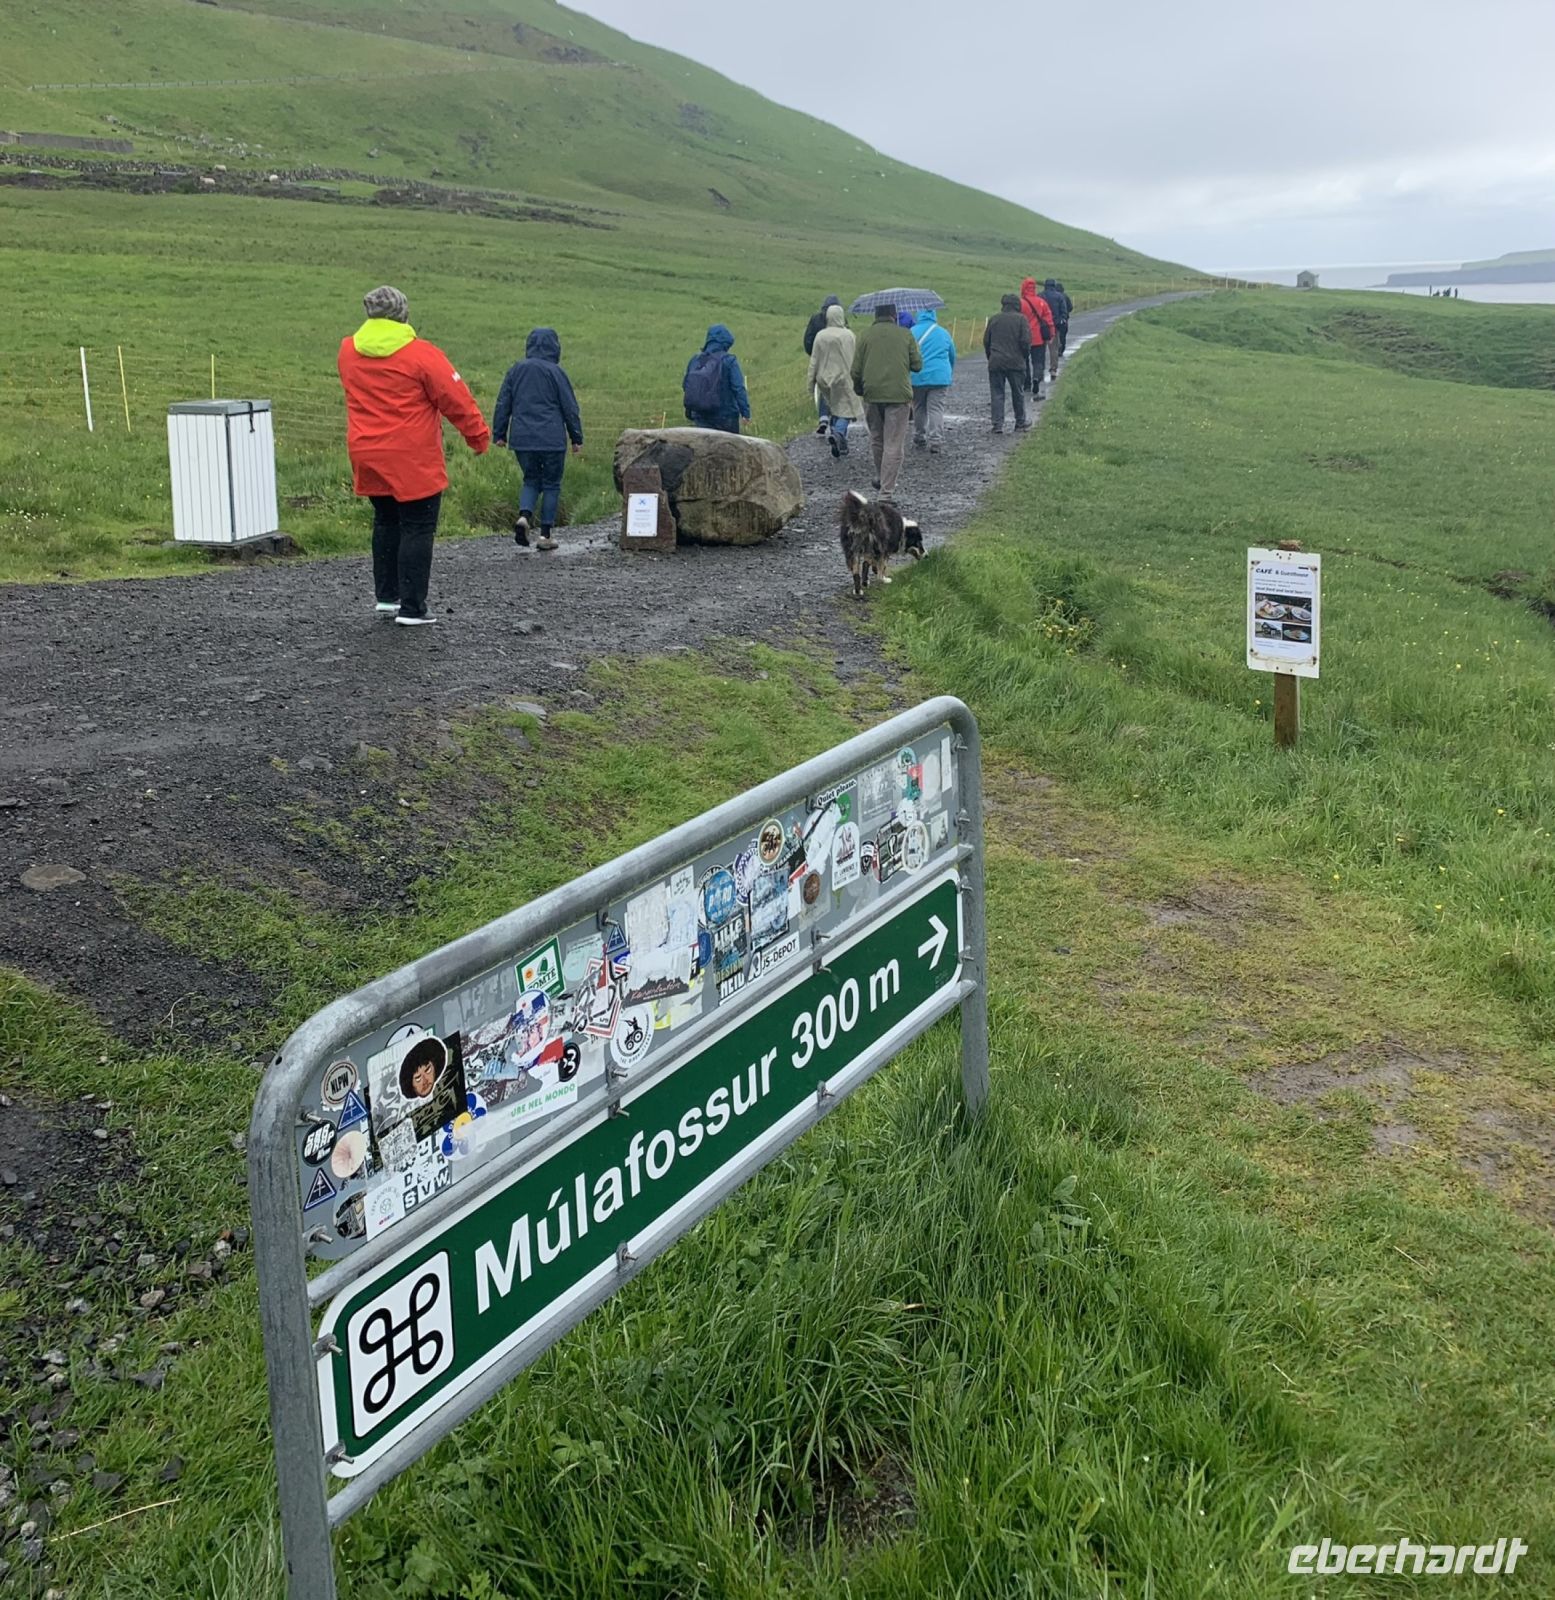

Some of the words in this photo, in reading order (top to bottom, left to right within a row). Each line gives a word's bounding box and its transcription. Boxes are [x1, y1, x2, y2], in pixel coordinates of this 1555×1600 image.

[817, 791, 835, 806] Quiet
[545, 1082, 576, 1102] MONDO
[474, 1045, 778, 1315] Múlafossur
[791, 976, 860, 1070] 300
[869, 957, 901, 1013] m
